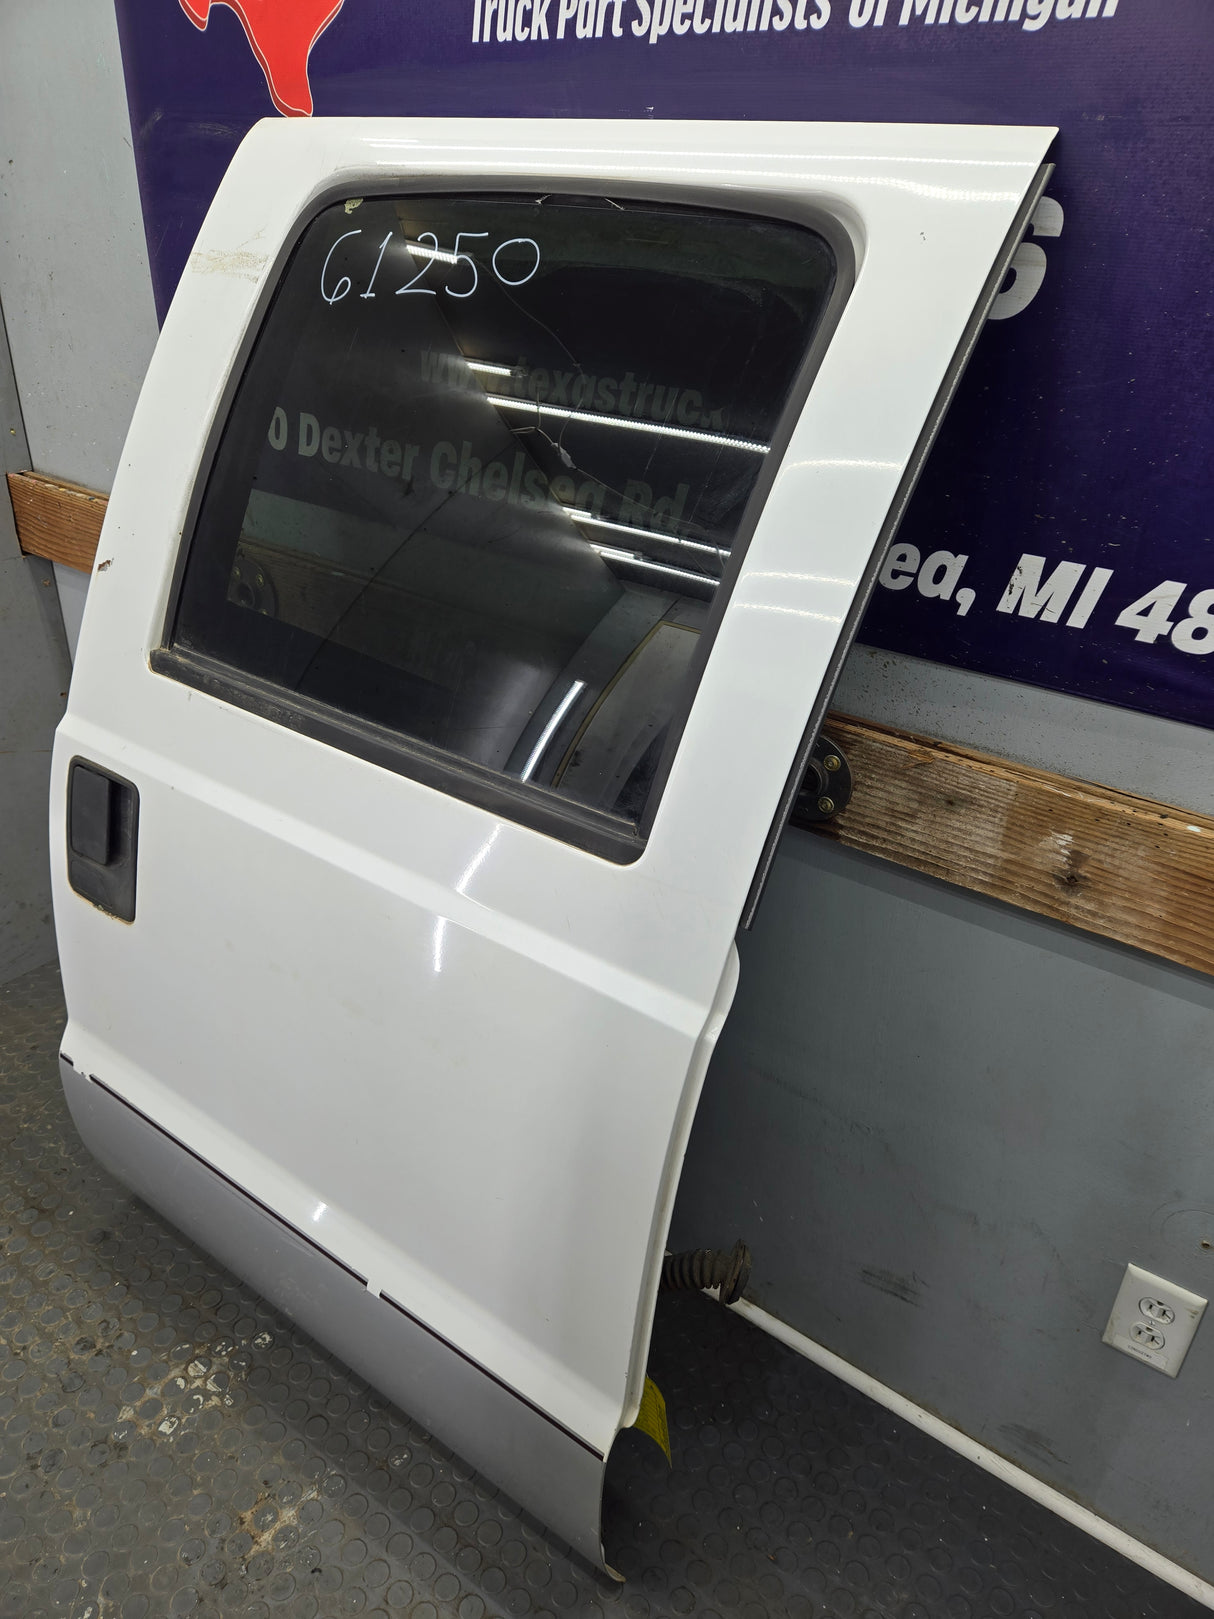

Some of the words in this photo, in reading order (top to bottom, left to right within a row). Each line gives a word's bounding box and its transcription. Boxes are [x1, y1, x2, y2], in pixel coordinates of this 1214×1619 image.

[472, 0, 551, 43] Truck
[556, 0, 626, 39] Part
[631, 0, 832, 44] Specialists
[321, 228, 540, 305] 61250
[298, 411, 421, 482] Dexter
[430, 439, 607, 522] Chelsea
[996, 553, 1114, 629] MI
[1114, 580, 1214, 655] 48
